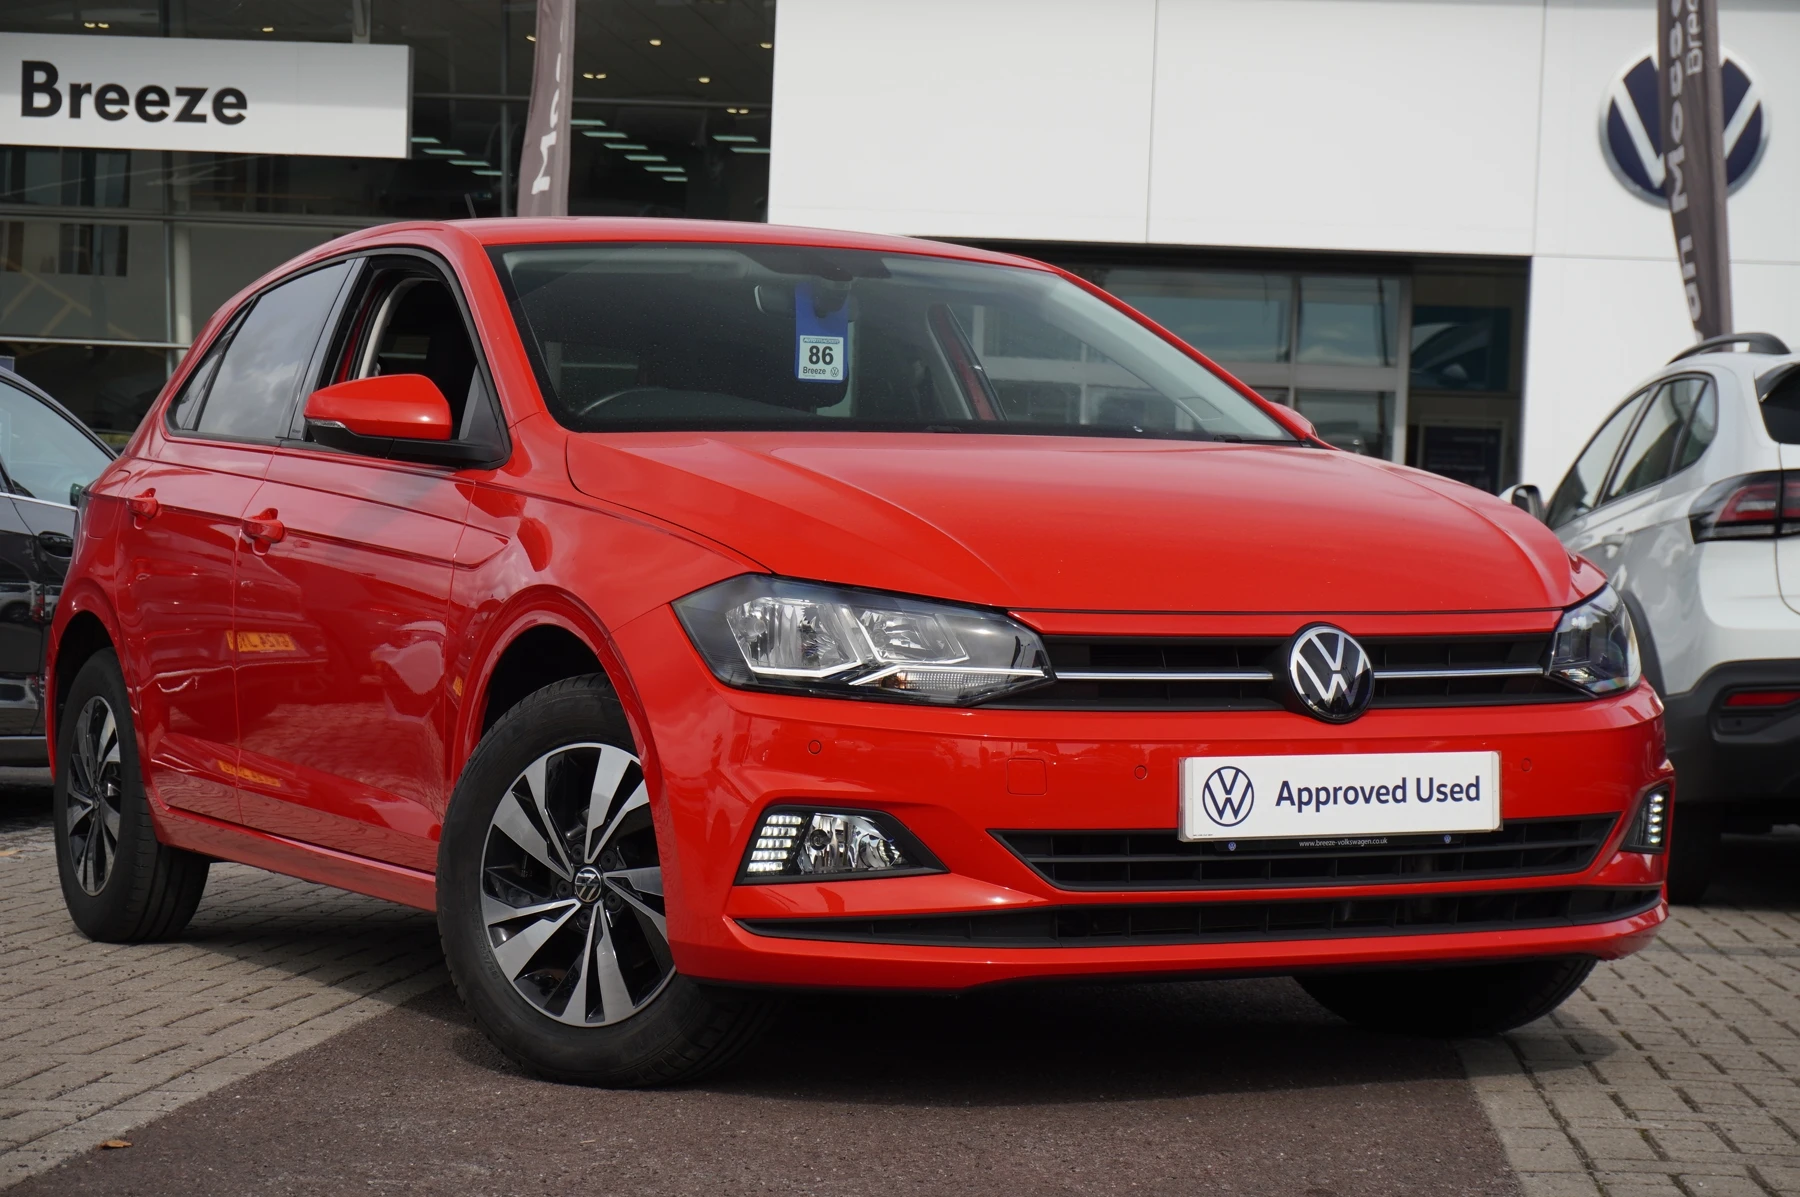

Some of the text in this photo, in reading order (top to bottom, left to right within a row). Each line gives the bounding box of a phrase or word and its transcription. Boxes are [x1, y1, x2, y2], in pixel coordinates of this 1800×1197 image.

[21, 60, 248, 126] Breeze
[808, 345, 834, 365] 86
[803, 366, 826, 375] Breeze
[1275, 775, 1481, 813] Approved Used
[1299, 837, 1388, 847] www.breeze-volkswagen.co.uk
